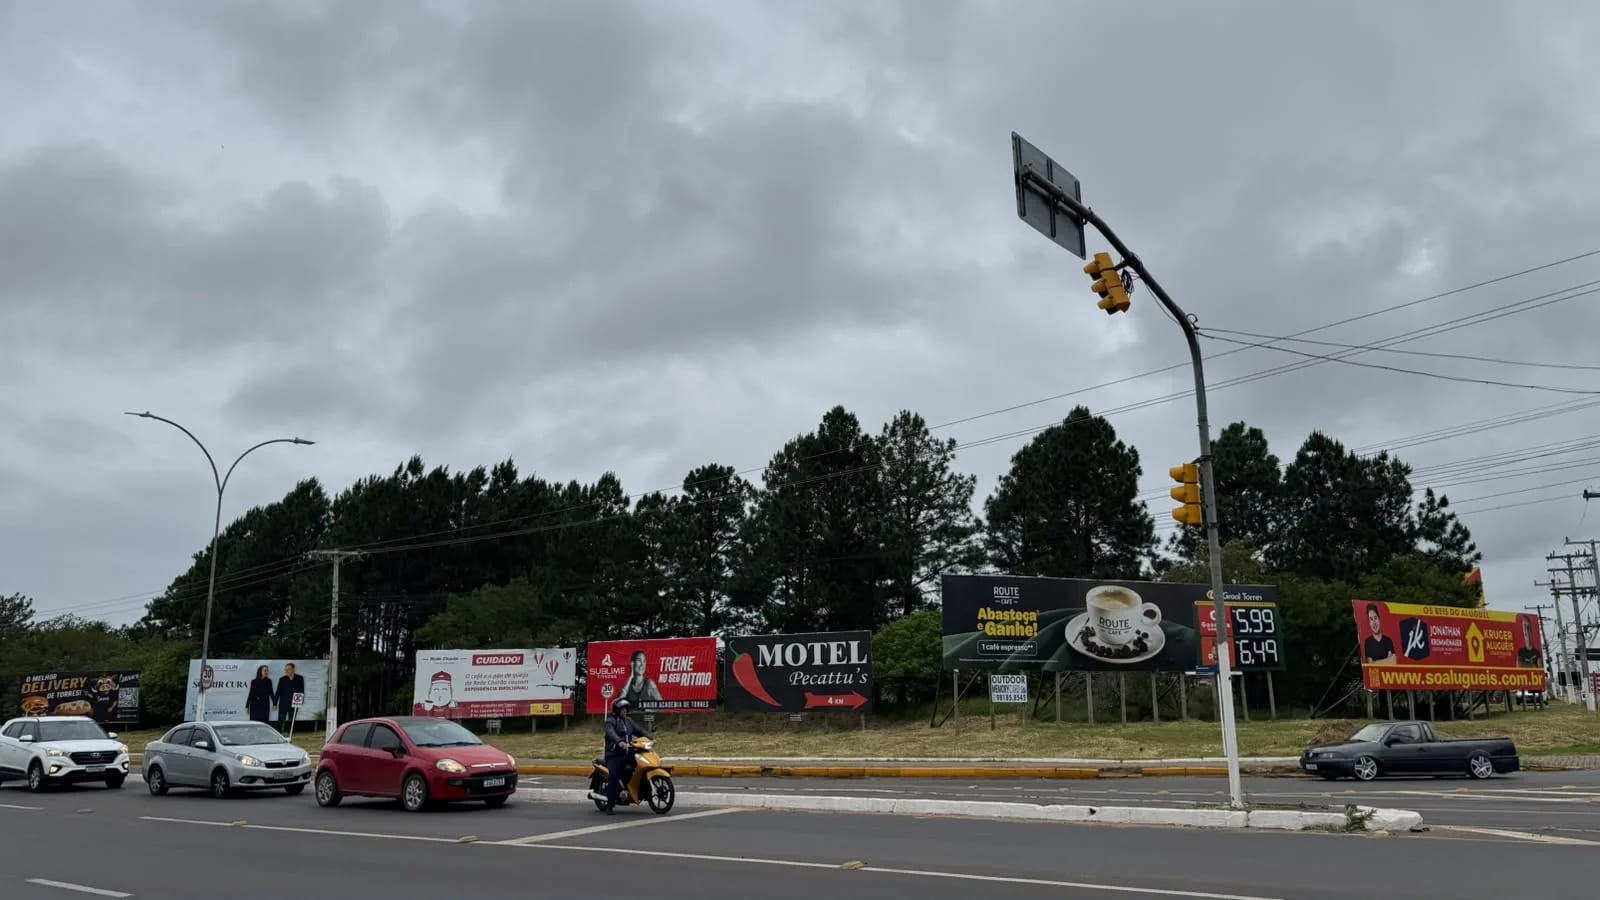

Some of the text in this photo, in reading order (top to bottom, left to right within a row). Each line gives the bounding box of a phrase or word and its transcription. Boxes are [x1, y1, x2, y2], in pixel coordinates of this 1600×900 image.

[994, 586, 1019, 596] ROUTE
[1242, 592, 1262, 600] Torres
[1100, 617, 1130, 628] ROUTE
[1236, 608, 1274, 632] 5,99
[984, 621, 1038, 636] Ganhe!
[1430, 626, 1460, 636] JONATHAN
[1484, 629, 1512, 640] KRUGER
[757, 640, 868, 667] MOTEL
[1240, 640, 1278, 664] 6,49
[476, 656, 521, 664] CUIDADO!
[660, 656, 696, 672] TREINE
[204, 670, 212, 678] 30
[590, 666, 626, 675] SUBLIME
[668, 674, 681, 683] SEU
[680, 672, 712, 686] RITMO
[789, 668, 868, 686] Pecattu's
[992, 676, 1025, 684] OUTDOOR
[1382, 670, 1543, 688] www.soalugueis.com.br
[22, 677, 88, 694] DELIVERY
